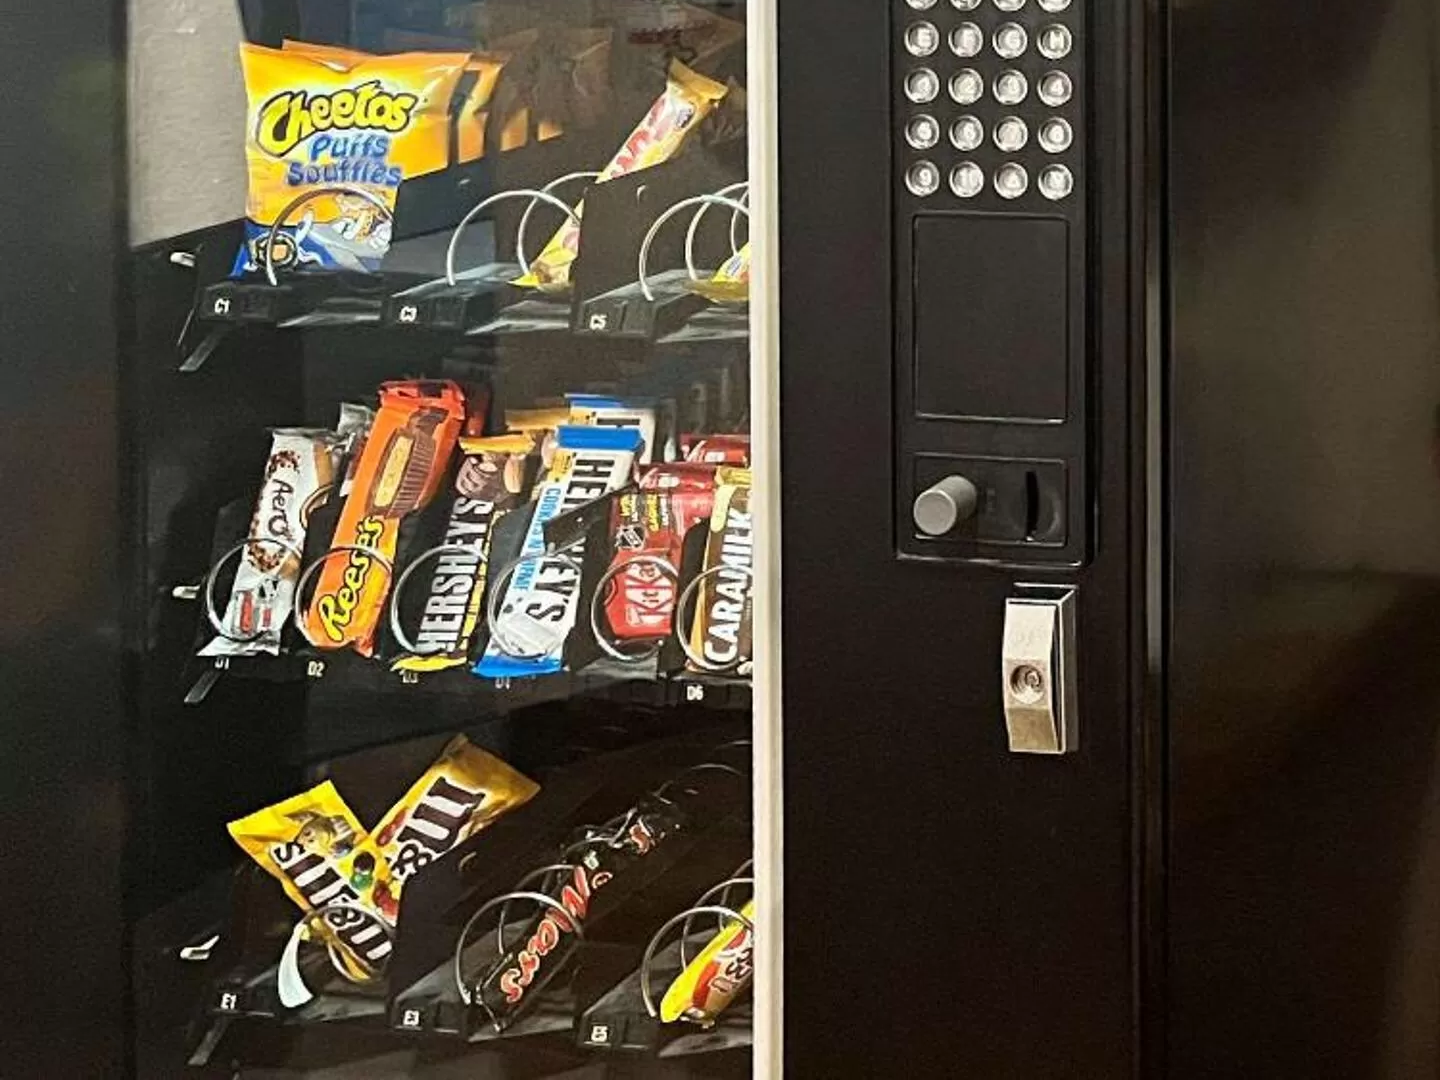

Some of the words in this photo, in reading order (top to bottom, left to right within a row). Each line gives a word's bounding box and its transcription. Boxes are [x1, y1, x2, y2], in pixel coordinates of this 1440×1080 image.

[256, 80, 418, 157] Cheetos
[310, 135, 389, 161] Puffs
[316, 515, 386, 643] Reese's
[415, 496, 494, 653] HERSHEY'S
[702, 506, 752, 664] CARAMILK
